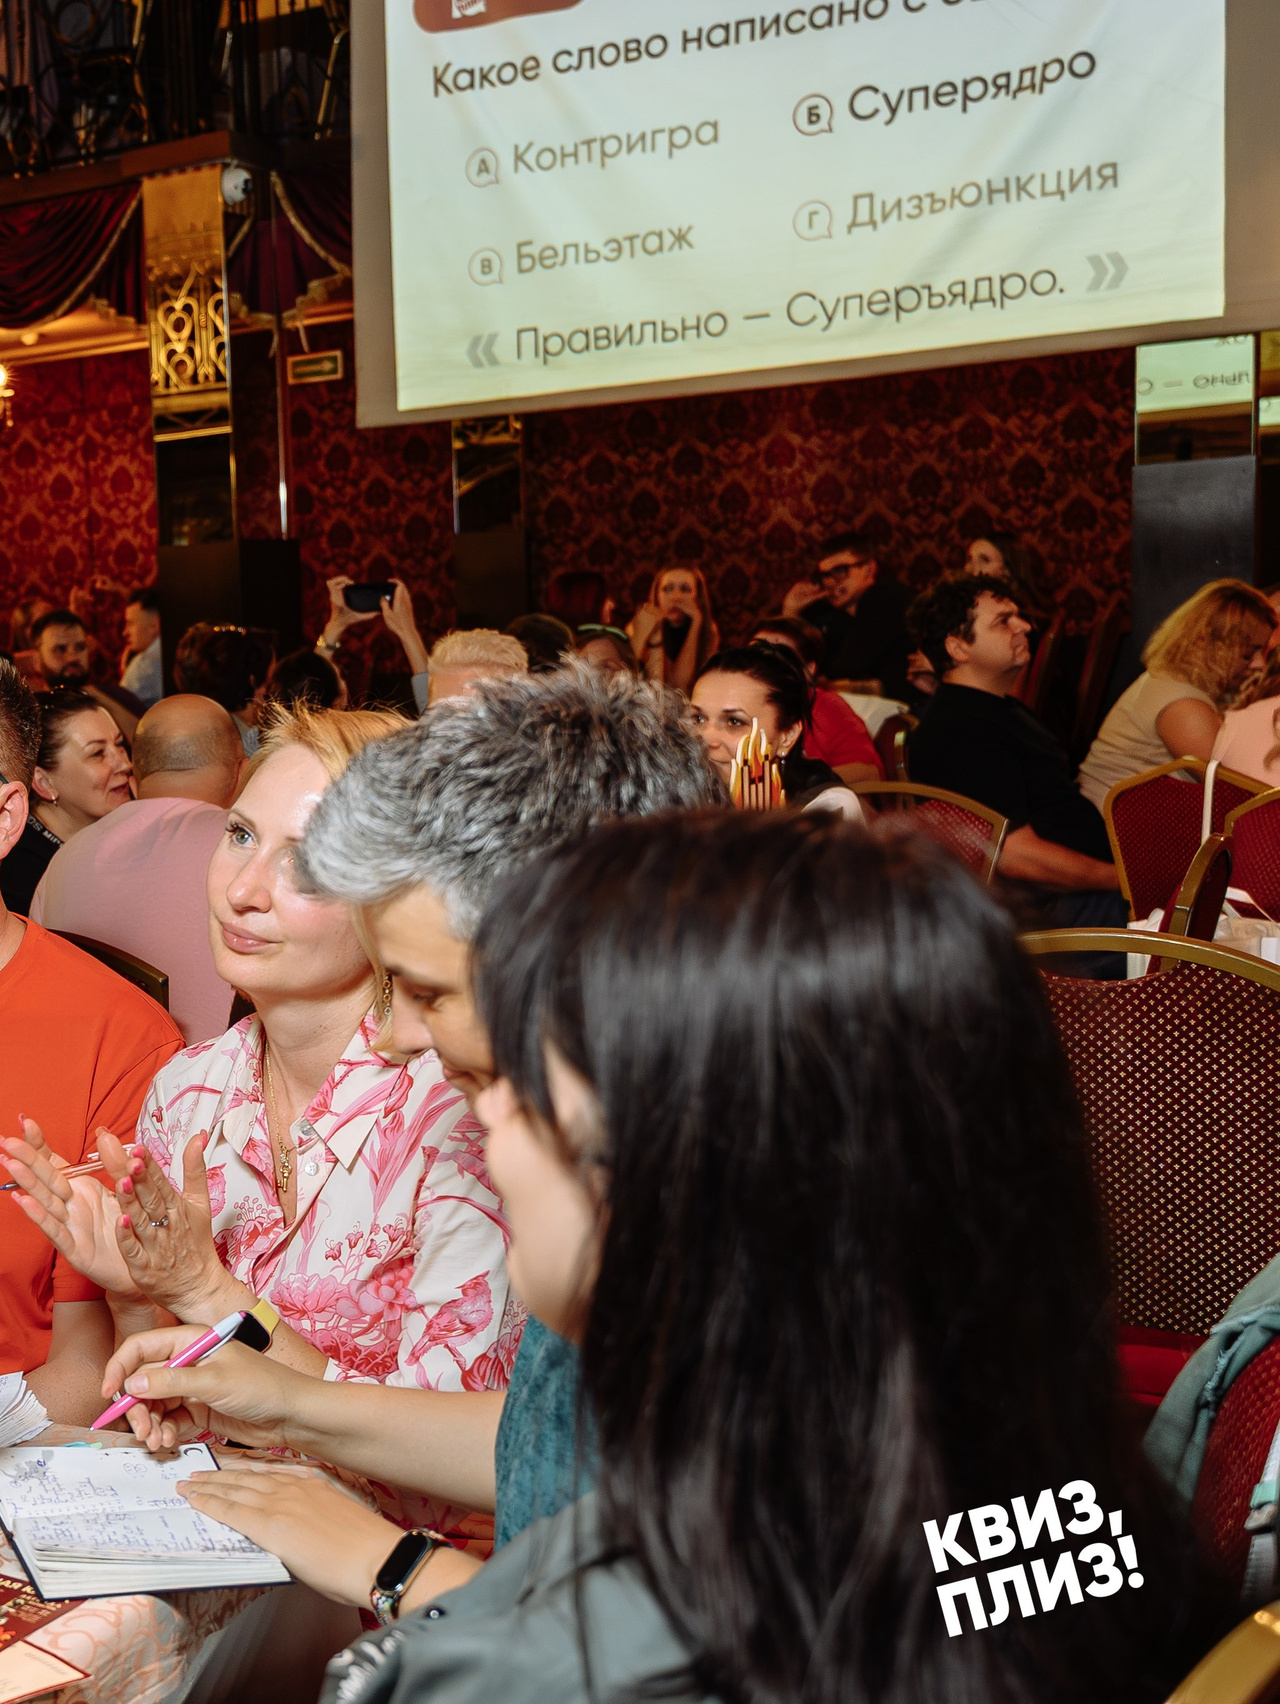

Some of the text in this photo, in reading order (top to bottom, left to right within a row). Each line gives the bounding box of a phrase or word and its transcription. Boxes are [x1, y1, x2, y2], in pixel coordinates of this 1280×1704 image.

[432, 55, 541, 98] Какое
[551, 34, 668, 75] слово
[681, 0, 889, 54] написано
[847, 51, 1097, 126] Суперядро
[513, 119, 719, 173] Контригра
[847, 161, 1119, 234] Дизъюнкция
[515, 224, 695, 275] Бельэтаж
[515, 311, 728, 365] Правильно
[786, 269, 1065, 332] Суперъядро.
